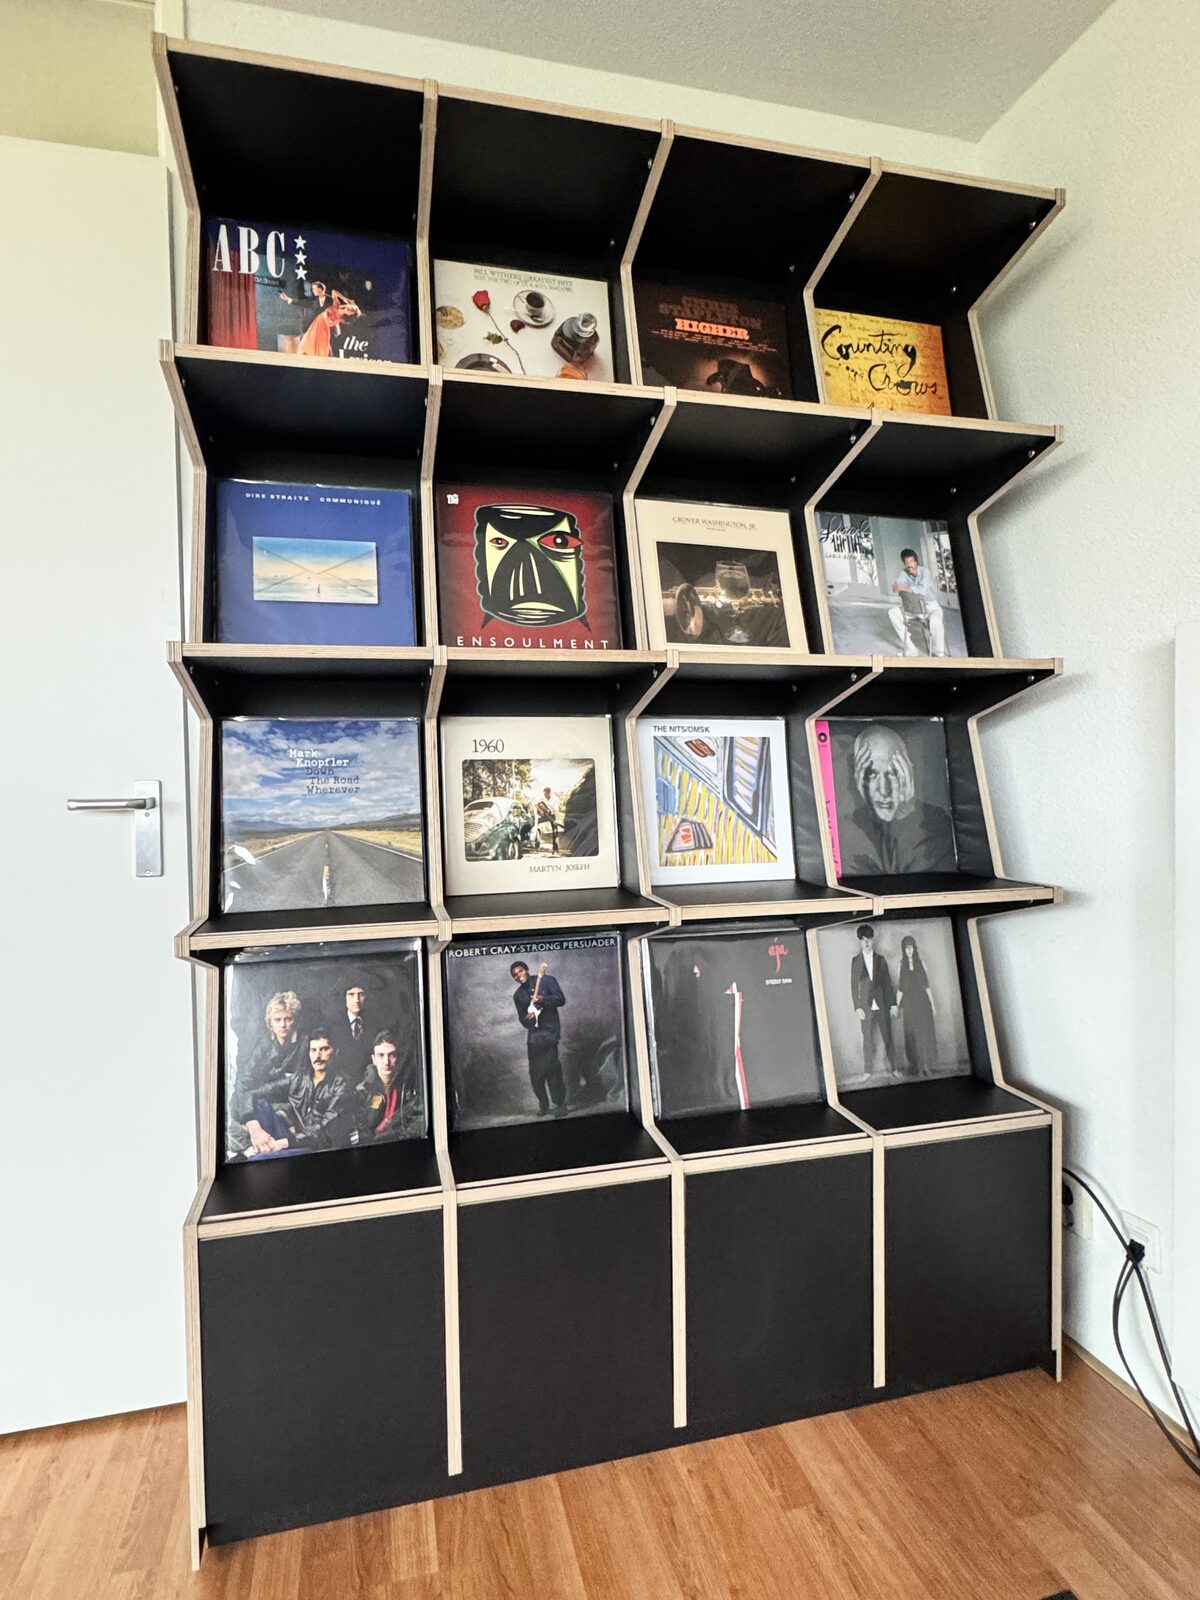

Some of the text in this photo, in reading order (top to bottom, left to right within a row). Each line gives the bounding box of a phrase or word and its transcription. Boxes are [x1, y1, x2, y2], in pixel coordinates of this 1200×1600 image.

[212, 223, 286, 279] ABC
[675, 318, 750, 341] HIGHER
[342, 335, 369, 352] the
[821, 324, 917, 379] Counting
[868, 363, 938, 396] Crows
[270, 494, 309, 502] STRAITS
[320, 496, 381, 506] COMMUNIQUÉ
[672, 516, 700, 525] GROVER
[457, 636, 609, 650] ENSOULMENT
[653, 725, 711, 734] THE NITS/OMSK
[472, 738, 505, 754] 1960
[288, 748, 319, 758] Mark
[295, 757, 350, 769] Knopfler
[306, 767, 335, 776] Down
[309, 775, 360, 785] The Road
[306, 785, 361, 795] Wherever
[529, 863, 591, 873] MARTYN JOSEPH
[448, 947, 488, 958] ROBERT
[562, 938, 617, 950] PERSUADER
